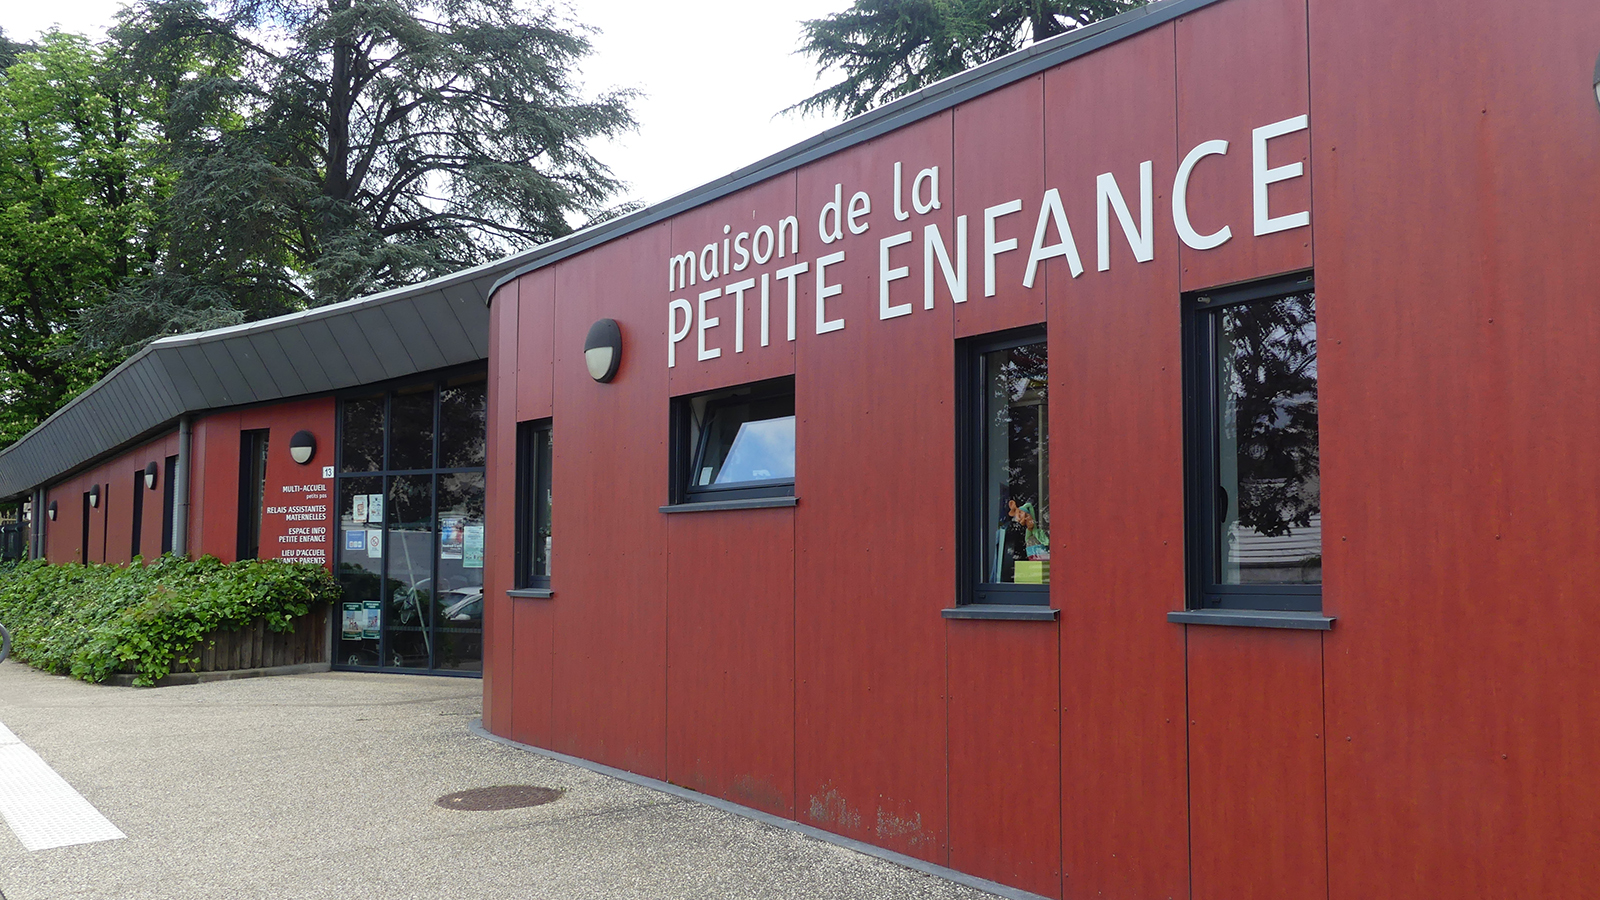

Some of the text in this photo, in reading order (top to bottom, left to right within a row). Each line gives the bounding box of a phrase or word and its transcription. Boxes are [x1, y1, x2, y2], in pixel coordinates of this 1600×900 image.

[669, 161, 941, 292] maison de la
[668, 114, 1309, 368] PETITE ENFANCE
[325, 468, 332, 476] 13
[282, 484, 326, 492] MULTI-ACCUEIL
[311, 526, 326, 534] INFO
